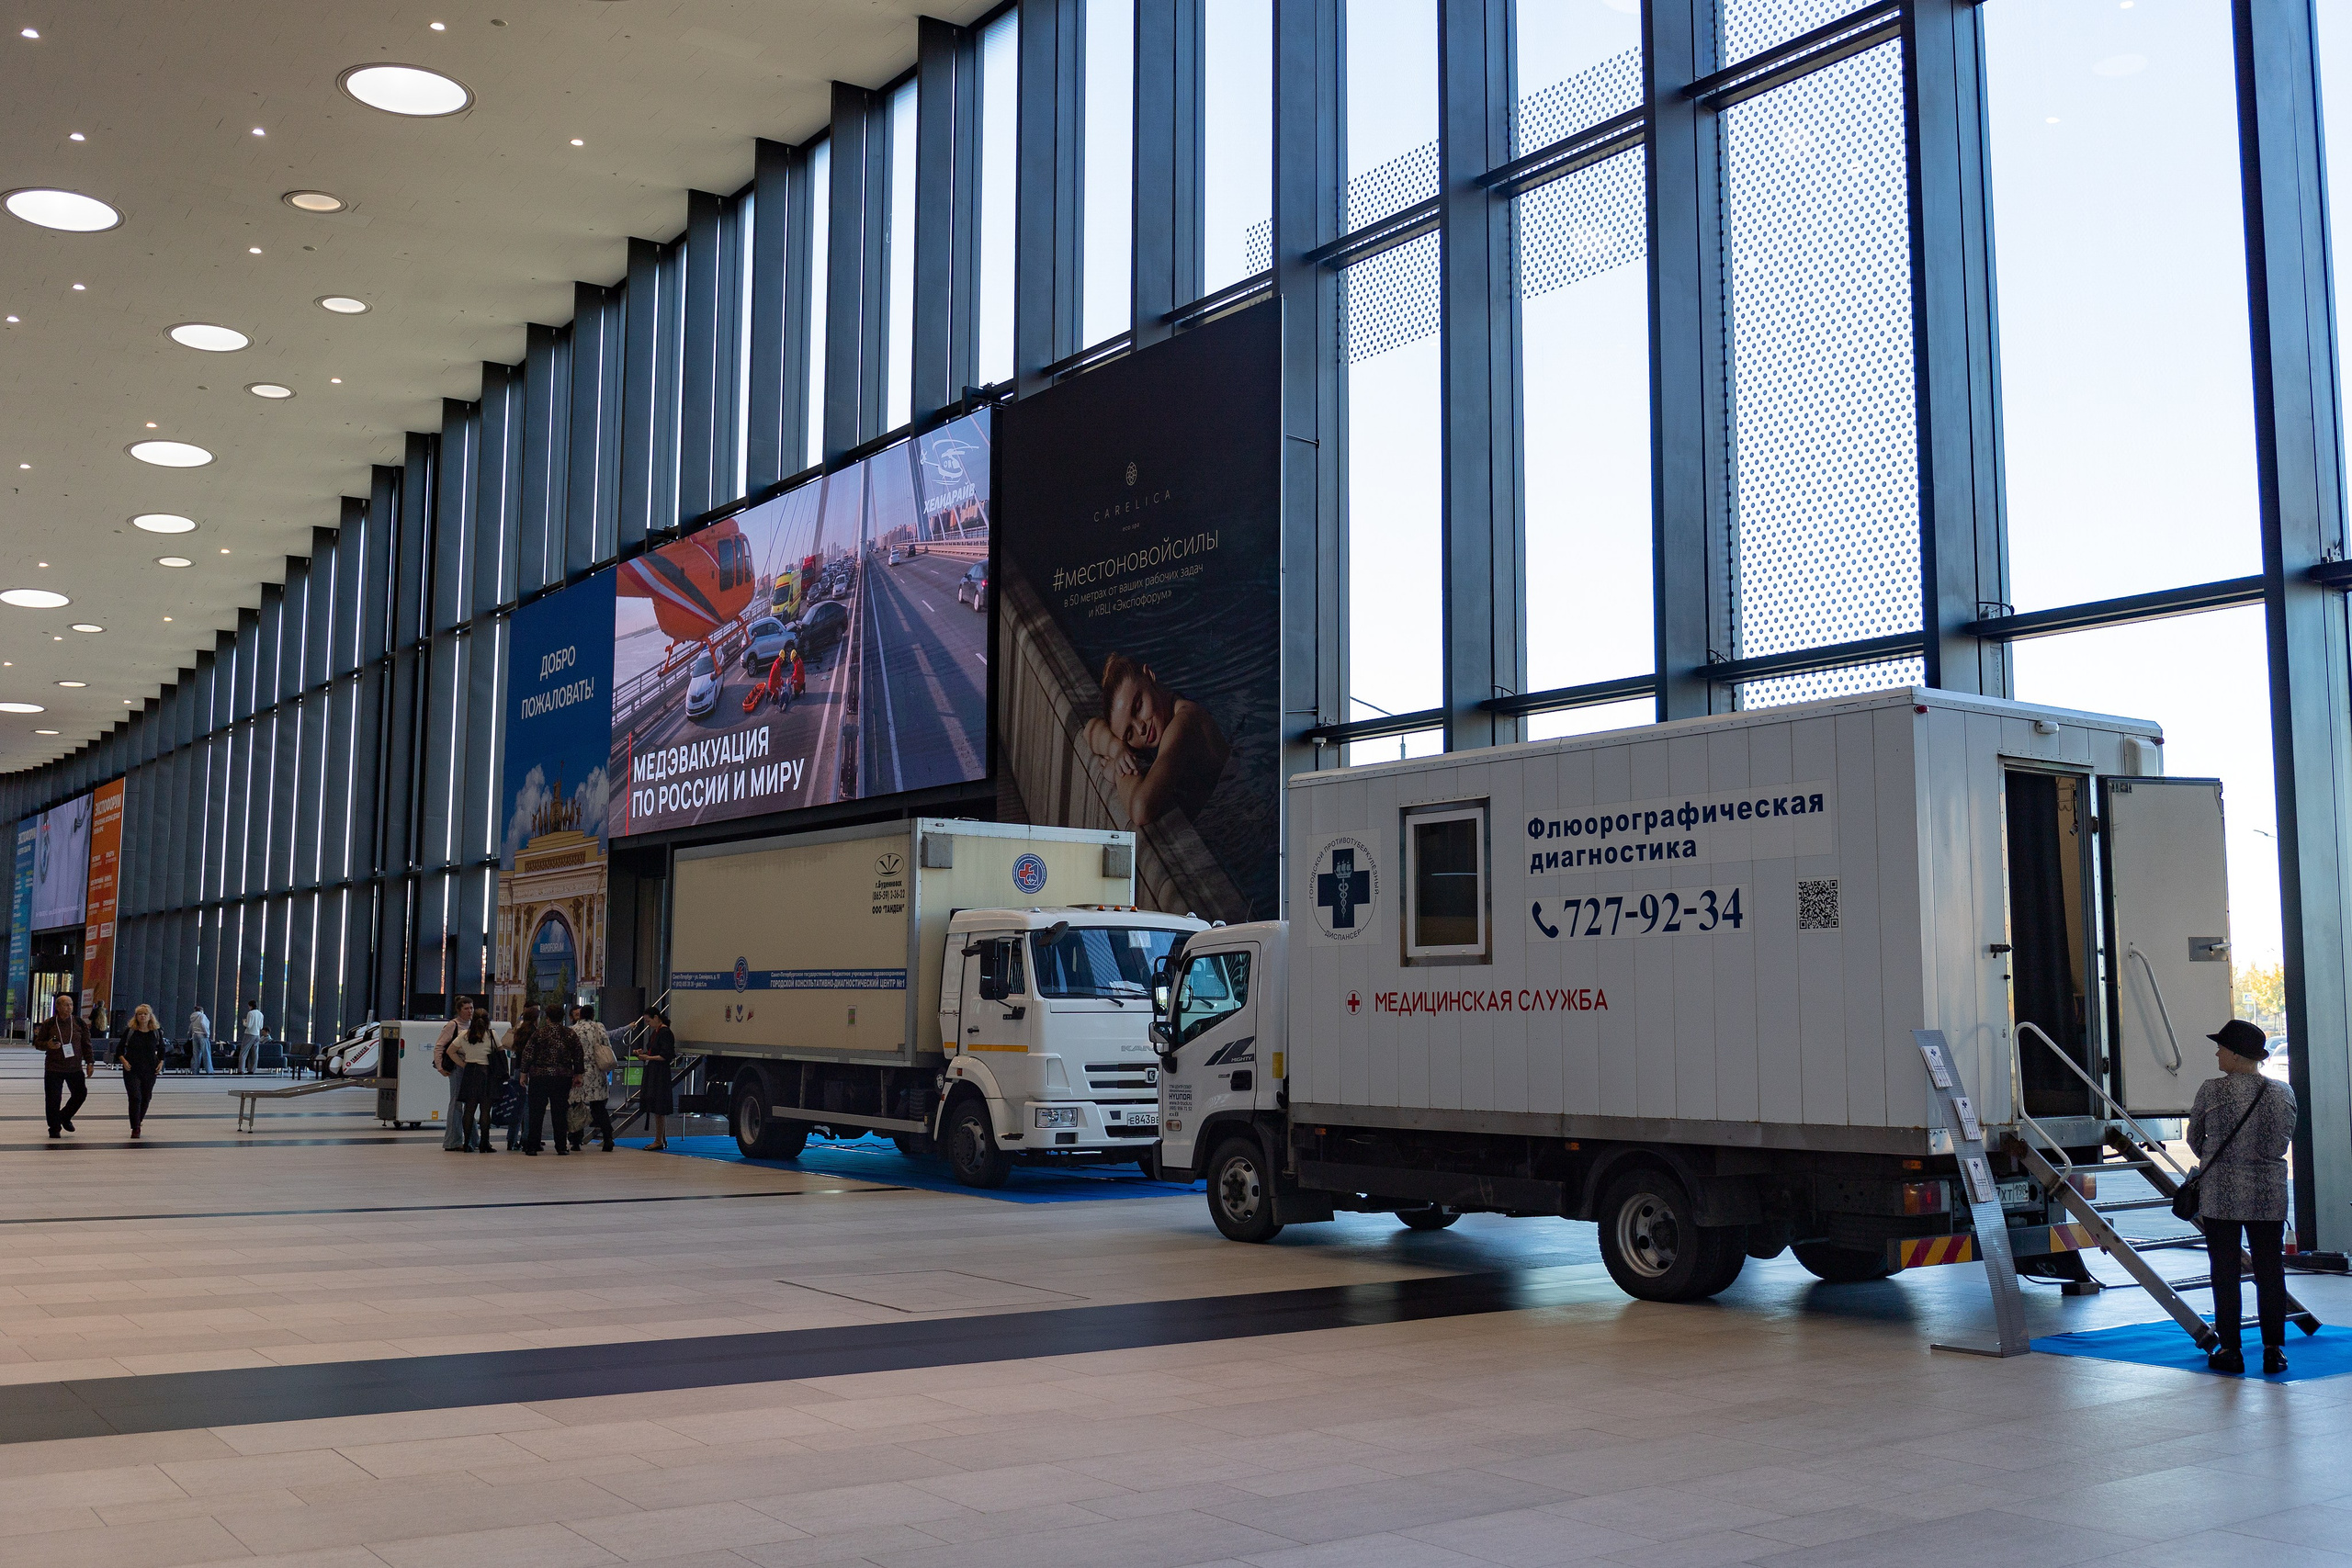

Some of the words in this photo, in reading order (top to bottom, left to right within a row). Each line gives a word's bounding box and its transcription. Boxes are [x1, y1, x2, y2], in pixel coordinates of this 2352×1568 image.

[923, 480, 976, 514] ХЕЛИДРАЙВ
[1093, 490, 1170, 522] CARELICA
[1069, 593, 1080, 607] 50
[1080, 589, 1107, 606] метрах
[1108, 585, 1118, 596] от
[1119, 581, 1144, 593] ваших
[1145, 570, 1179, 591] рабочих
[1180, 563, 1204, 580] задач
[1095, 604, 1111, 618] КВЦ
[539, 645, 576, 682] ДОБРО
[521, 676, 594, 720] ПОЖАЛОВАТЬ!
[633, 726, 770, 783] МЕДЭВАКУАЦИЯ
[632, 788, 655, 818] ПО
[658, 773, 729, 814] РОССИИ
[733, 770, 745, 801] И
[750, 758, 805, 797] МИРУ
[1527, 793, 1825, 840] Флюорографическая
[1308, 852, 1325, 899] ГОРОДСКОЙ
[1323, 837, 1379, 895] ПРОТИВОТУБЕРКУЛЕЗНЫЙ
[1530, 839, 1697, 874] диагностика
[872, 905, 882, 914] ООО
[1563, 887, 1744, 938] 727-92-34
[1325, 929, 1362, 941] ДИСПАНСЕР
[770, 977, 795, 988] ГОРОДСКОЙ
[880, 978, 896, 989] ЦЕНТР
[1374, 990, 1512, 1017] МЕДИЦИНСКАЯ
[1518, 988, 1609, 1011] СЛУЖБА
[1996, 1186, 2013, 1201] 7ХТ
